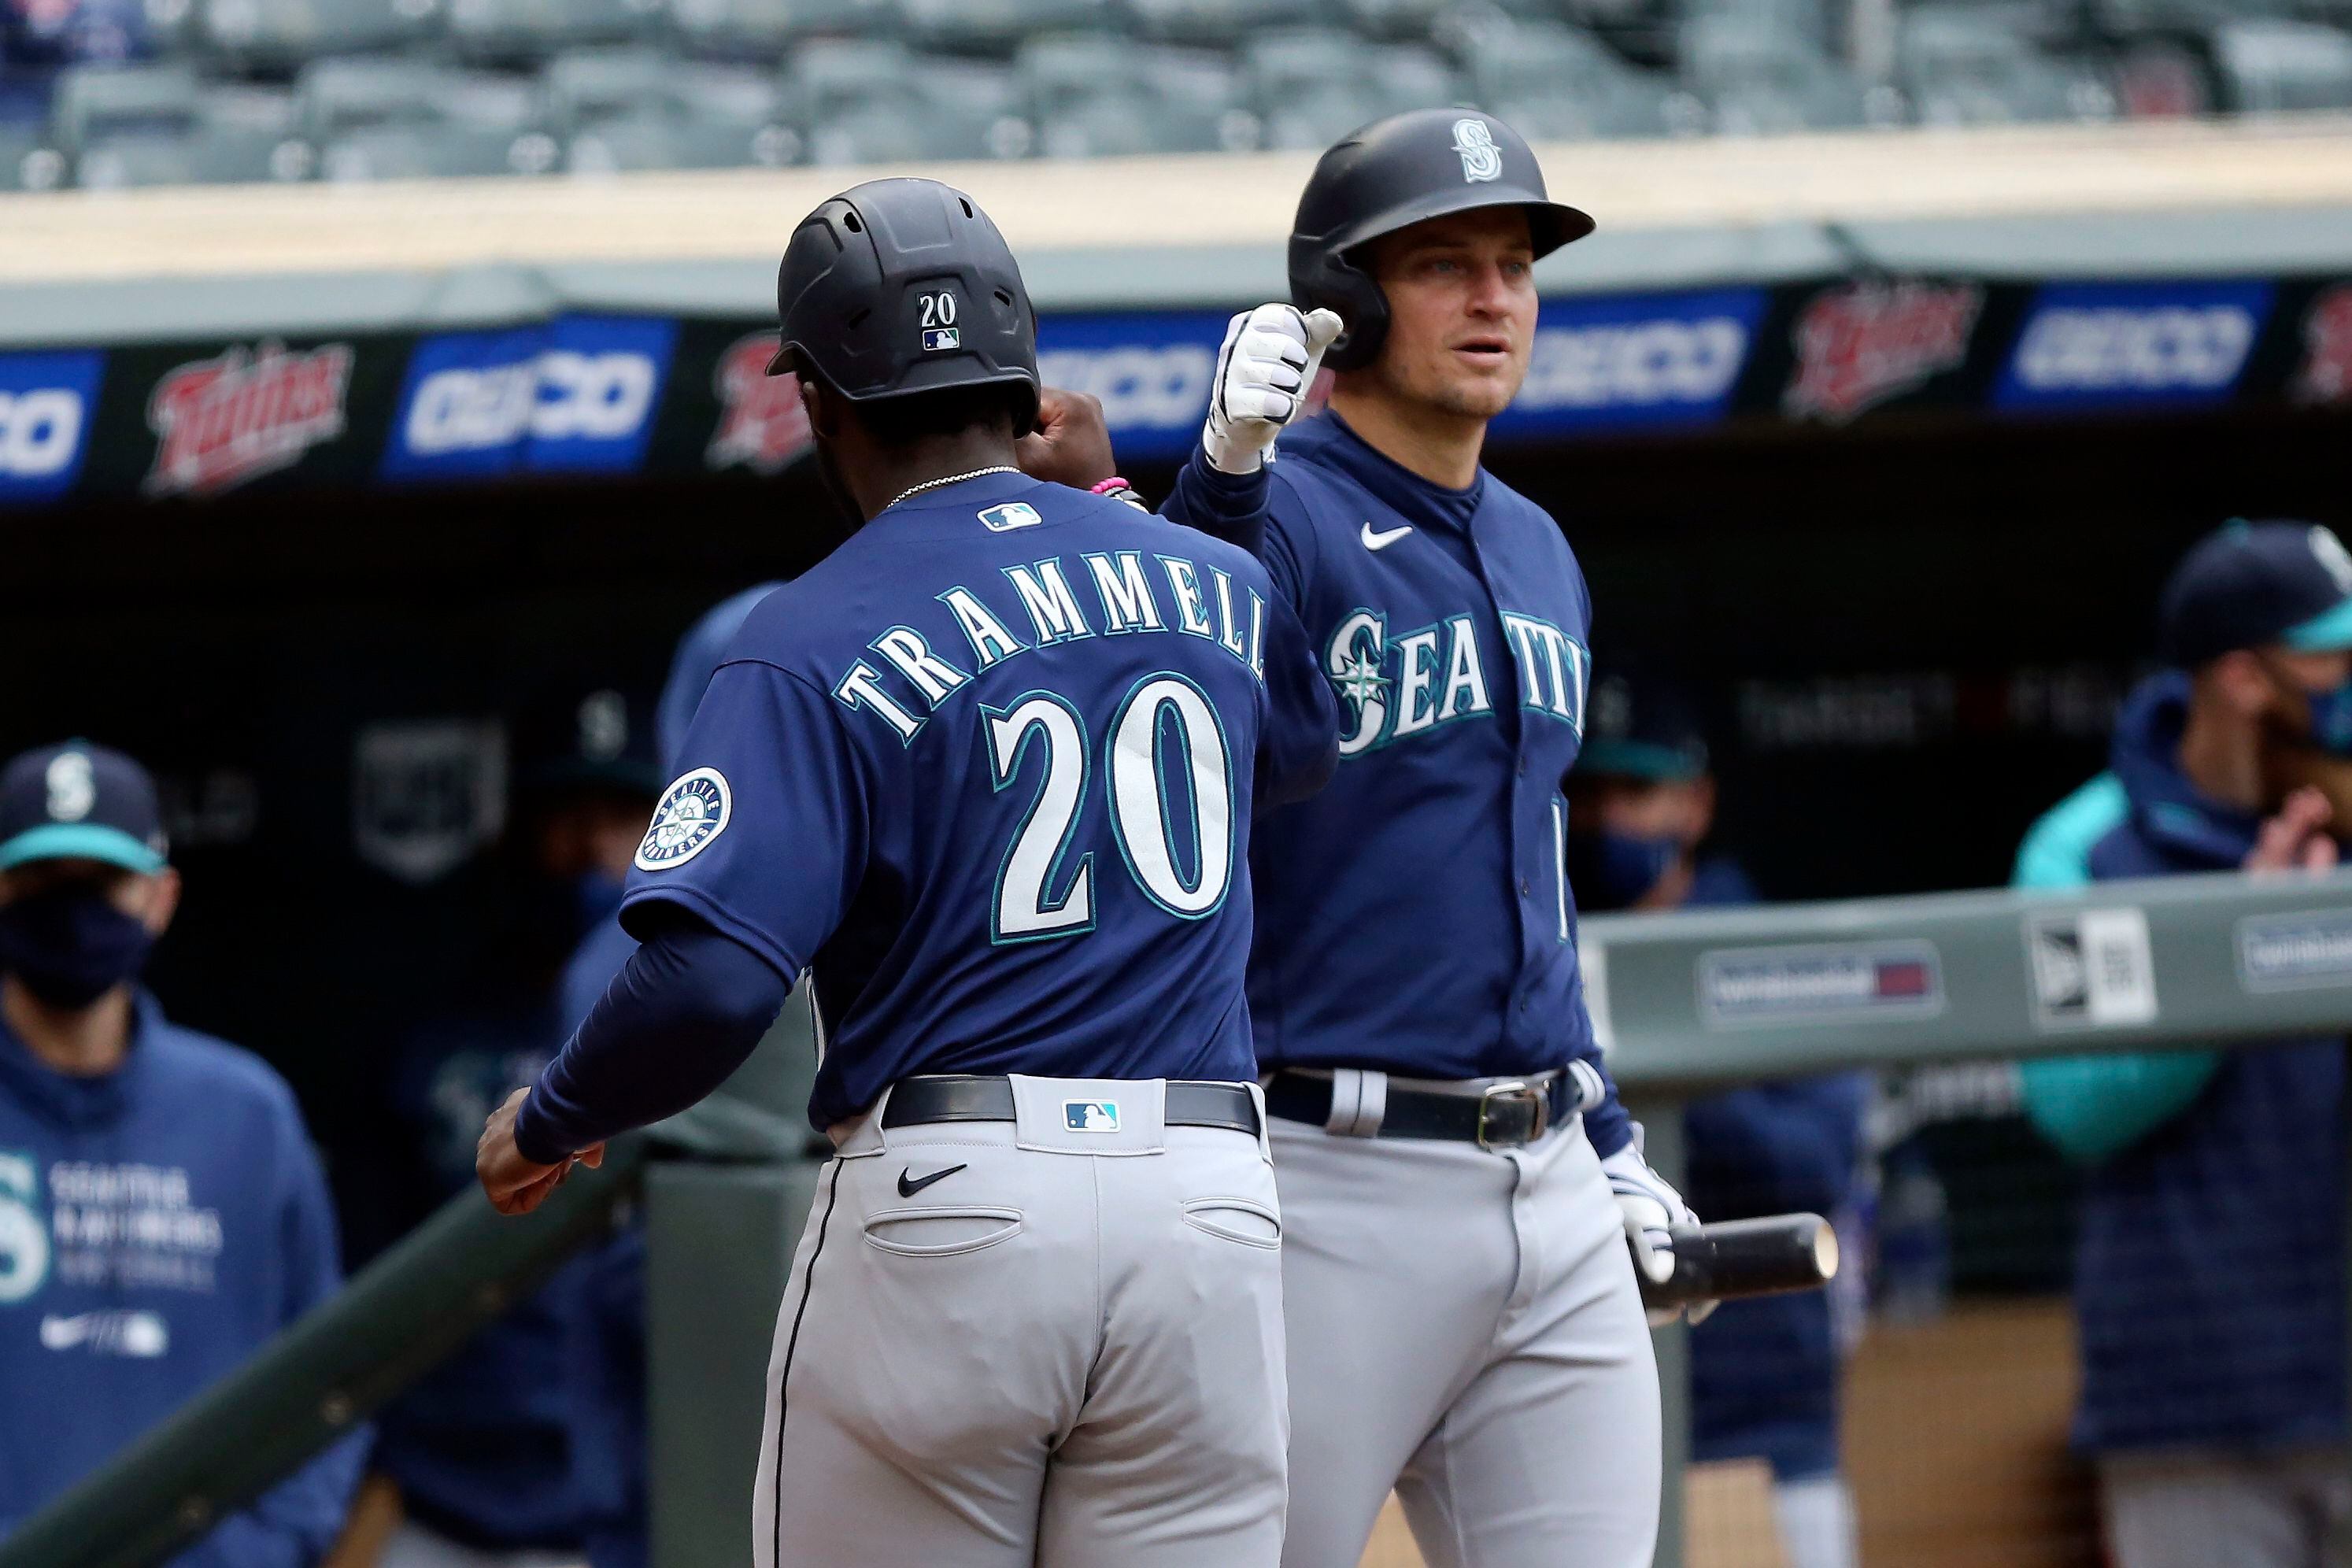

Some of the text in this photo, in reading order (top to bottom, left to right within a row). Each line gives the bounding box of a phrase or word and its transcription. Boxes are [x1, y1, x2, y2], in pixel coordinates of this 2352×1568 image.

[919, 292, 956, 327] 20
[831, 549, 1265, 749] TRAMMELL
[660, 780, 719, 817] SEATTLE
[978, 670, 1235, 945] 20
[644, 827, 709, 860] MARINERS
